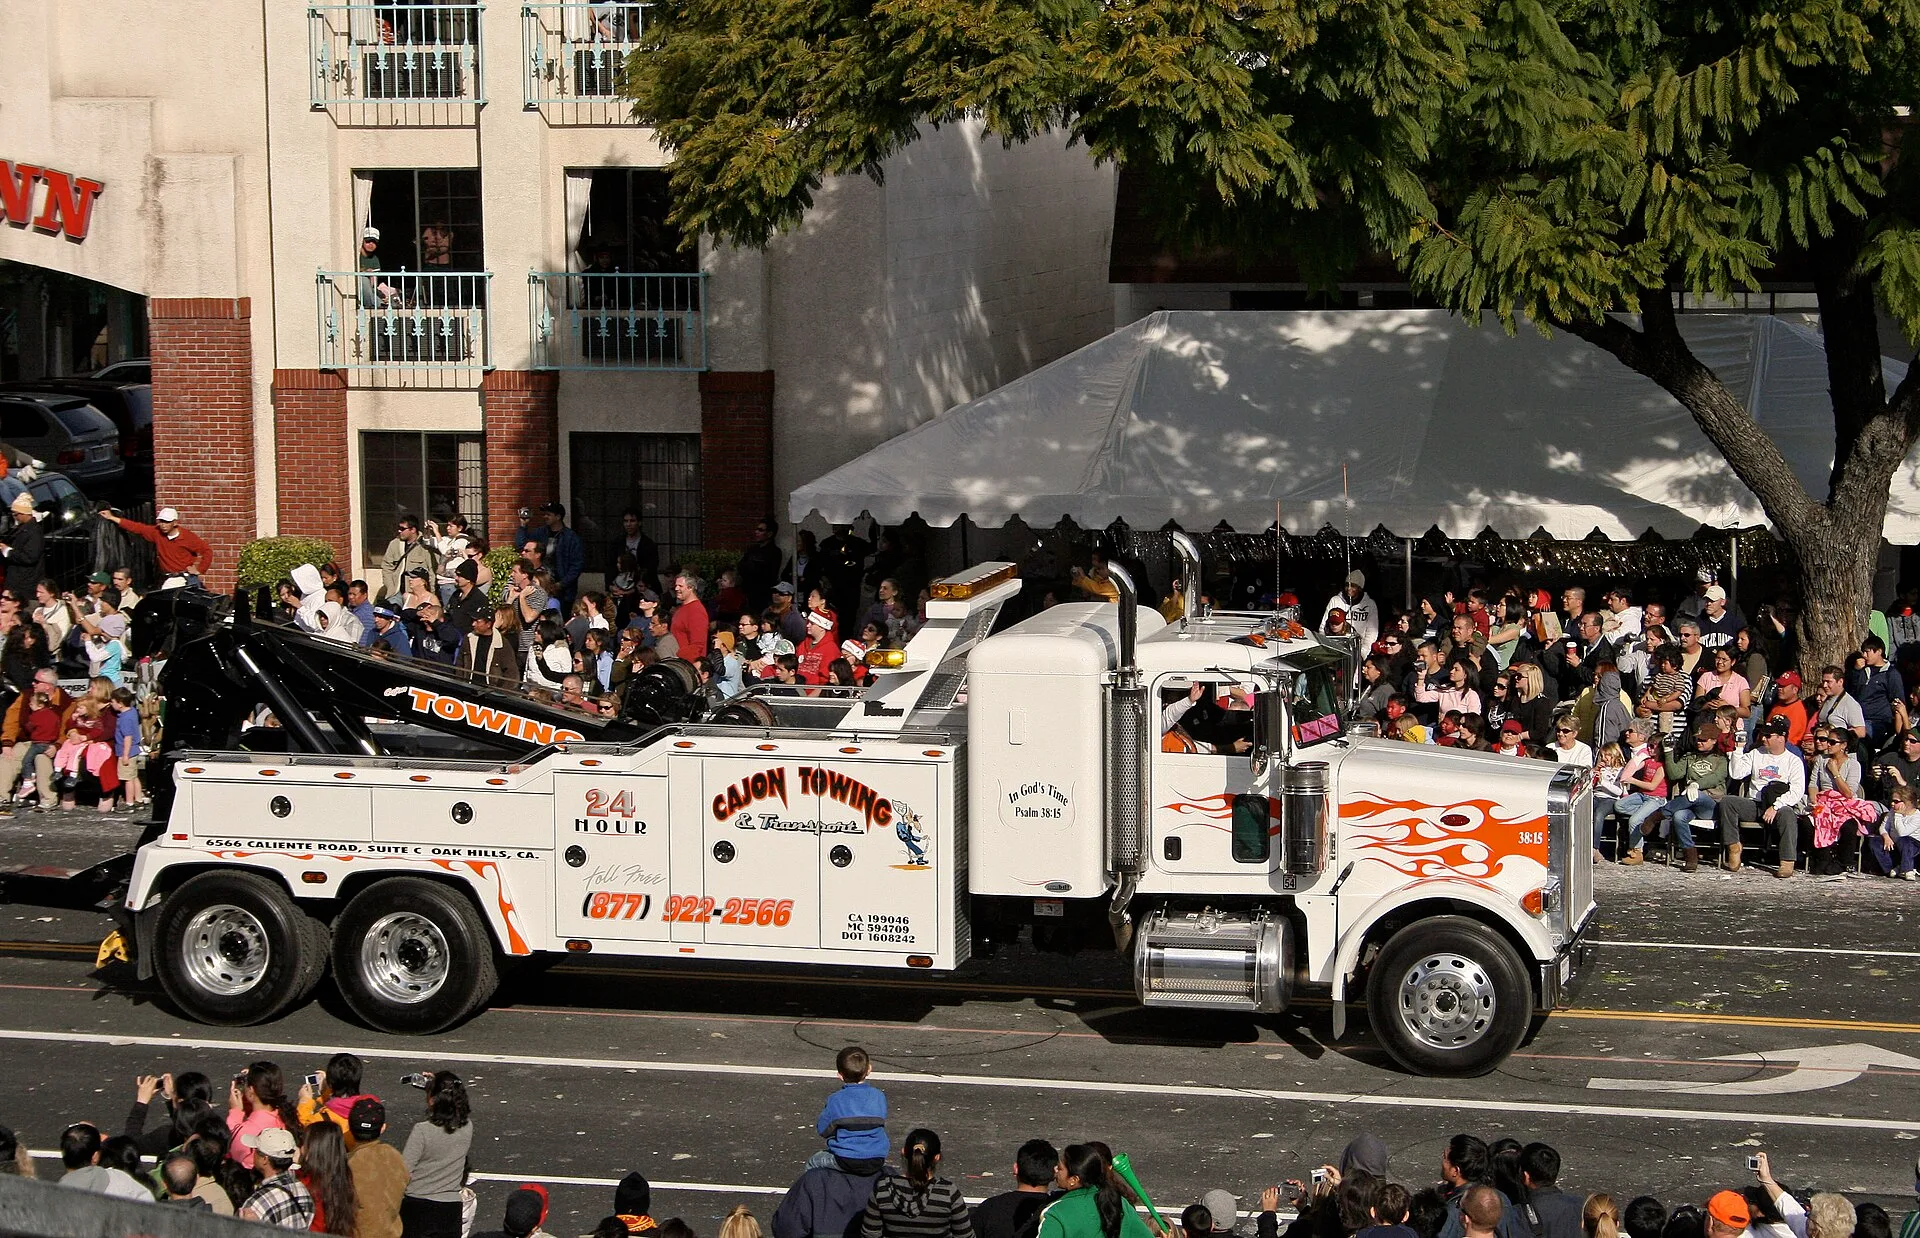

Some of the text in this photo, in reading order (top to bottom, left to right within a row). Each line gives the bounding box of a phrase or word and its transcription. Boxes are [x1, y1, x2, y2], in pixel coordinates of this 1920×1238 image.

[712, 766, 893, 834] CAJON TOWING
[1008, 781, 1069, 807] In God's Time
[584, 788, 636, 819] 24
[1015, 806, 1061, 819] Psalm 38:15
[575, 818, 648, 835] HOUR
[735, 812, 865, 836] & Transport
[1518, 831, 1543, 845] 38:15
[206, 839, 242, 847] 6566
[247, 840, 313, 850] CALIENTE
[318, 843, 362, 853] ROAD,
[367, 845, 408, 854] SUITE
[431, 848, 462, 856] OAK
[467, 849, 512, 859] HILLS,
[517, 851, 540, 859] CA.
[582, 891, 795, 928] (877) 922-2566
[847, 922, 910, 934] MC 594709
[848, 913, 910, 925] CA 199046
[841, 931, 915, 944] DOT 1608242
